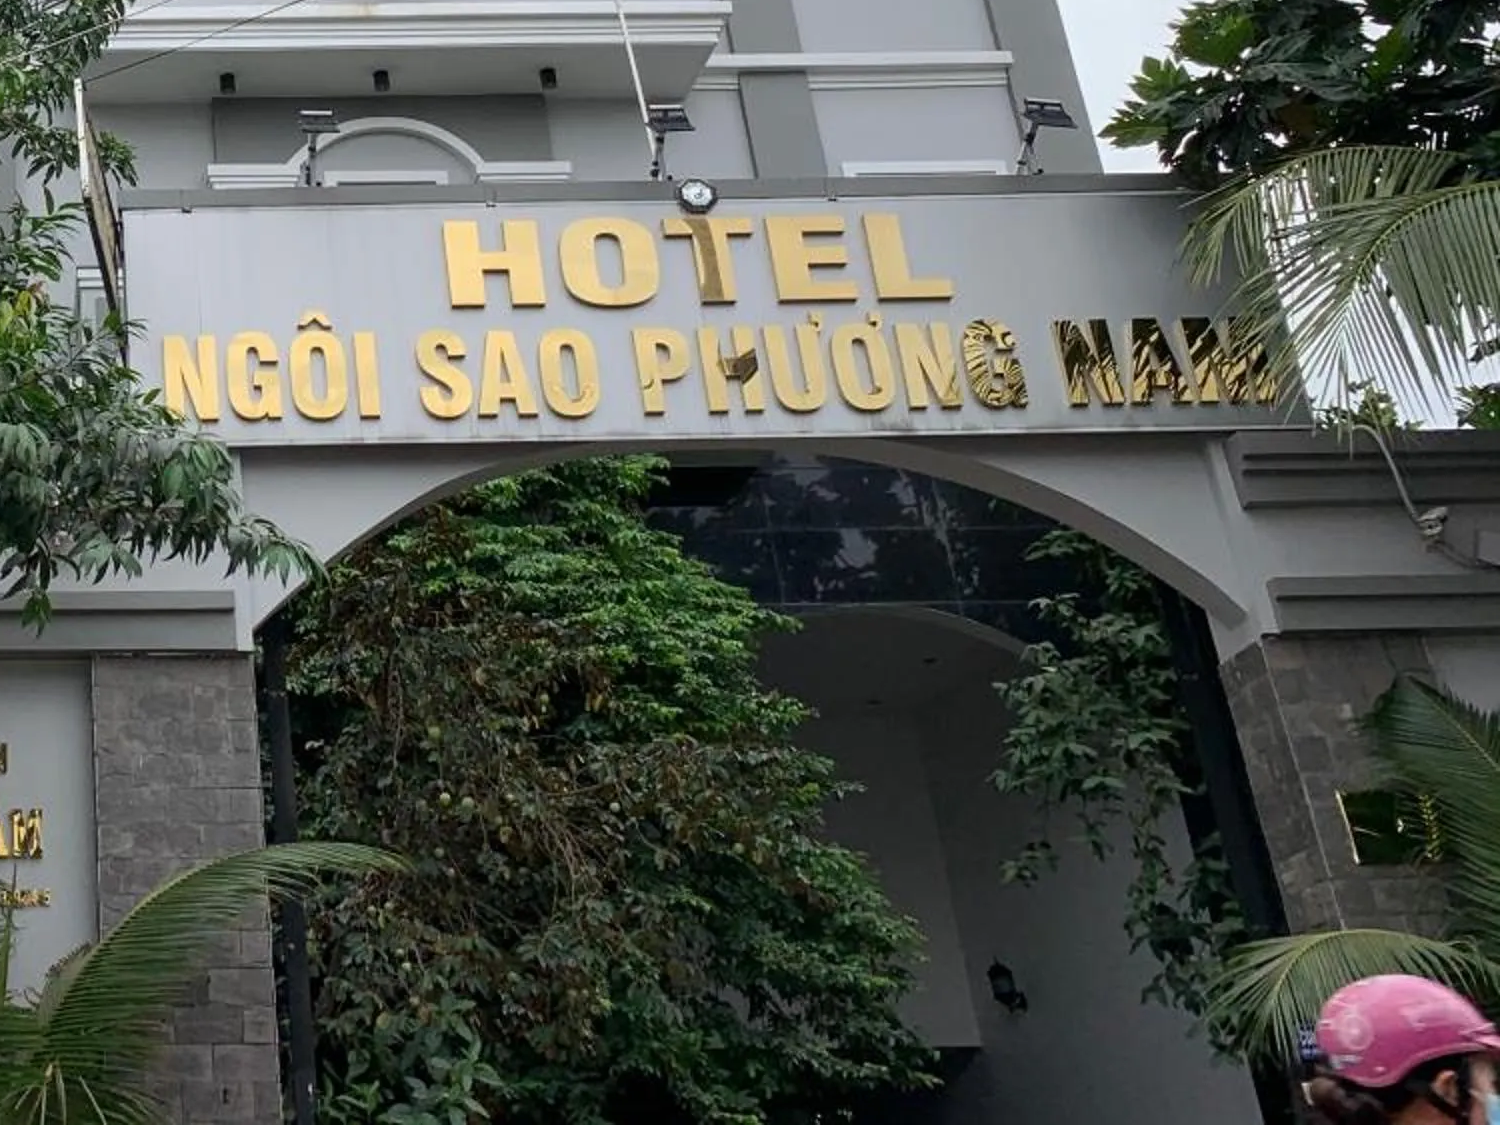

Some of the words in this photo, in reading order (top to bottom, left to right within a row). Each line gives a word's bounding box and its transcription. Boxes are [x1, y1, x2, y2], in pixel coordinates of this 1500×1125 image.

[442, 213, 955, 309] HOTEL
[163, 308, 381, 421] NGÔI
[415, 327, 600, 421] SAO
[631, 310, 1031, 416] PHƯƠNG
[1050, 315, 1280, 408] NAM
